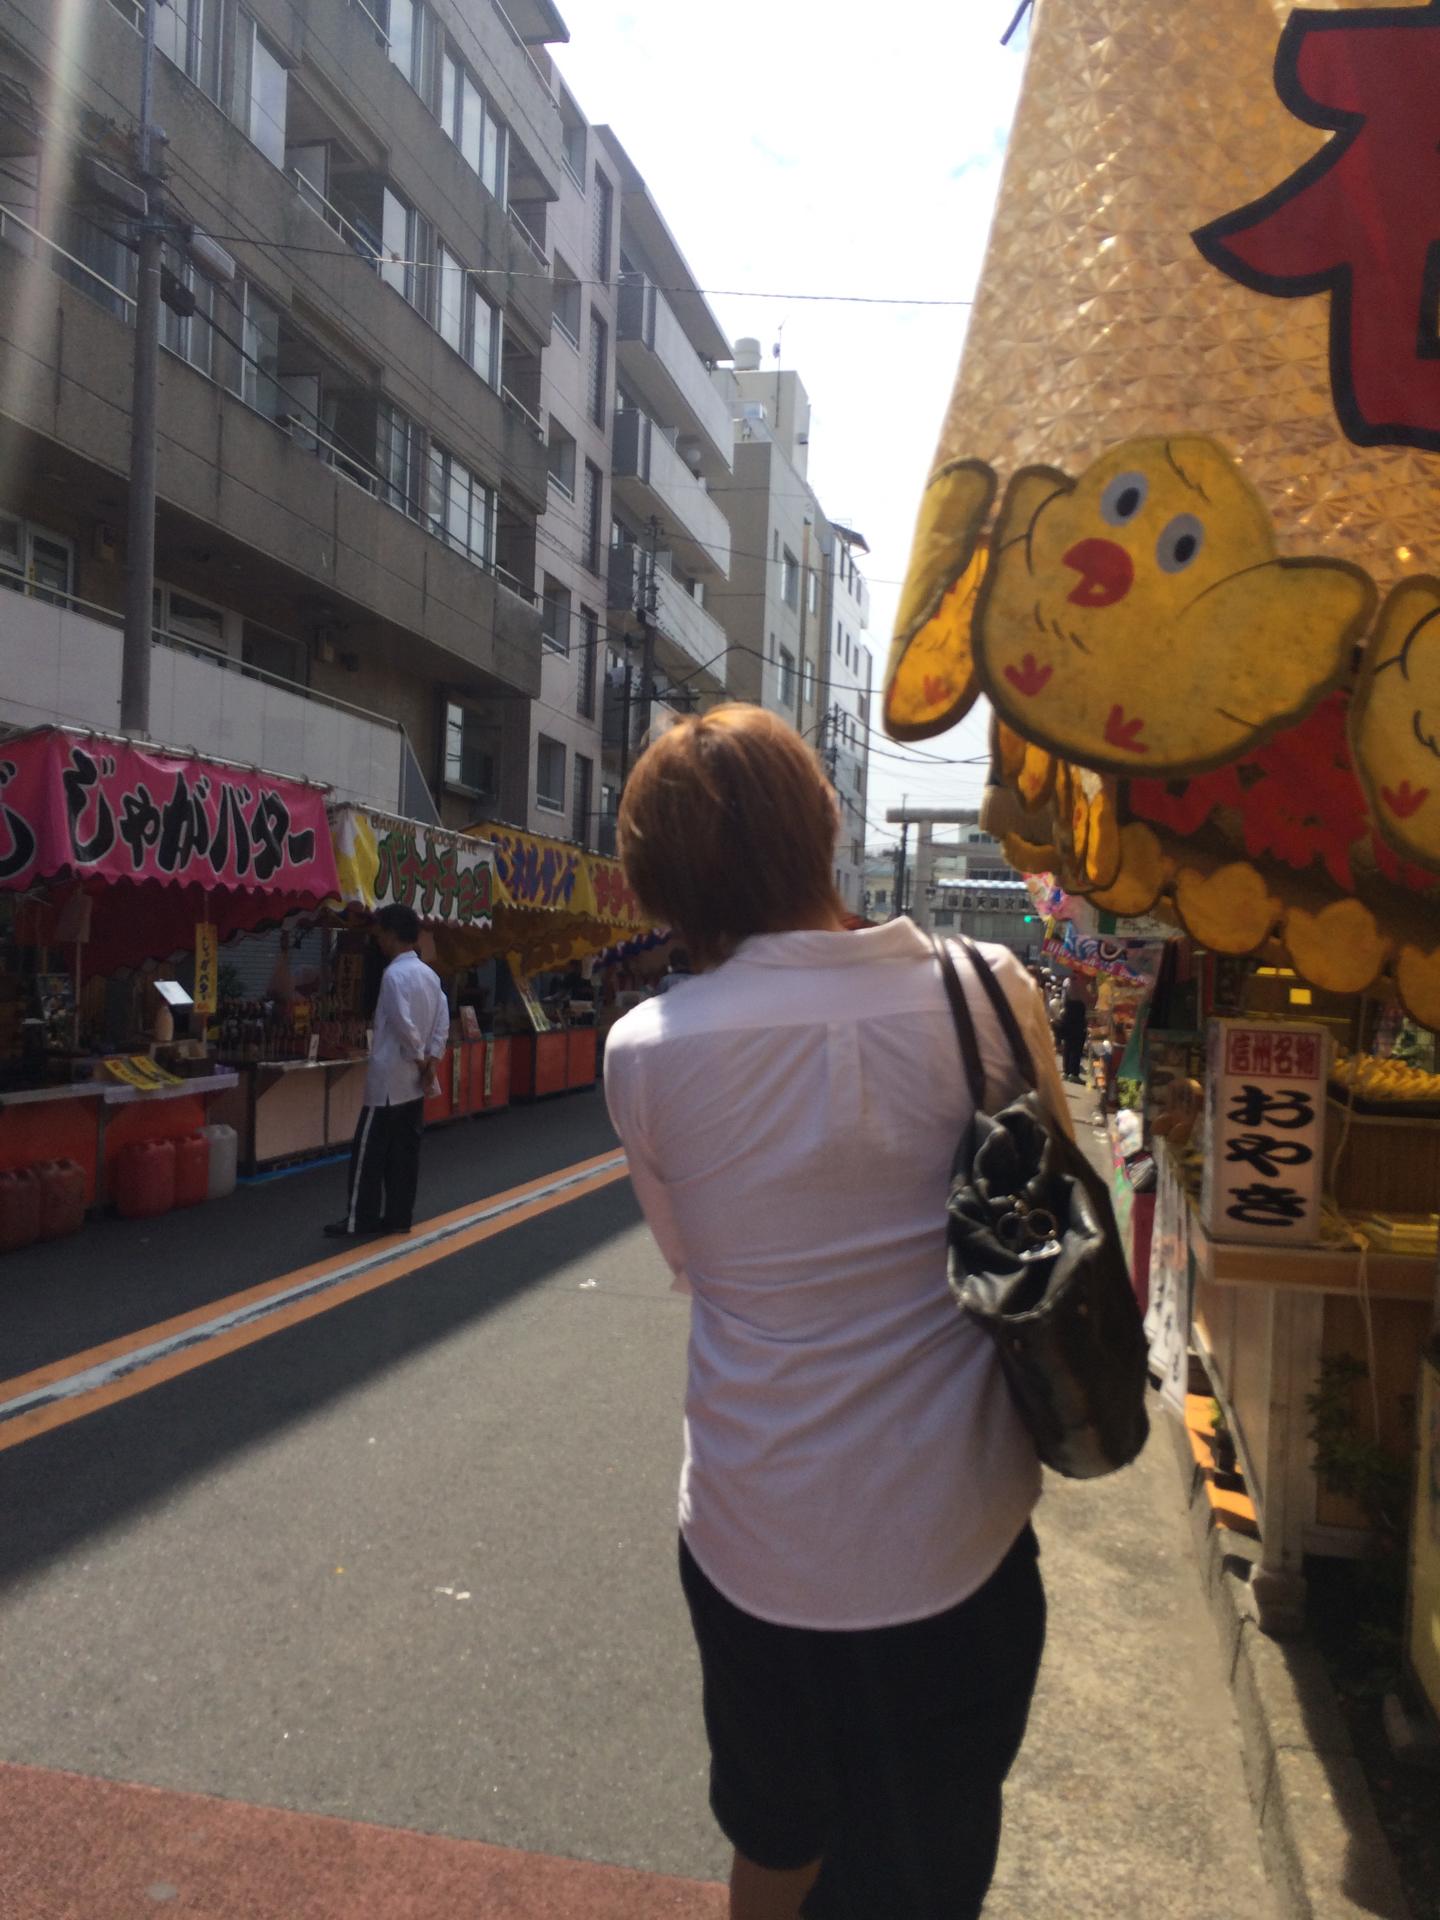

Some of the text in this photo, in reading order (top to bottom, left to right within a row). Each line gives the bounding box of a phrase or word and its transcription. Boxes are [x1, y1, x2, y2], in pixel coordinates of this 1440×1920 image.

[63, 747, 316, 880] じゃがバター
[375, 831, 493, 921] バナナチョコ
[1231, 1032, 1316, 1075] 信州名物
[1225, 1084, 1315, 1227] おやき
